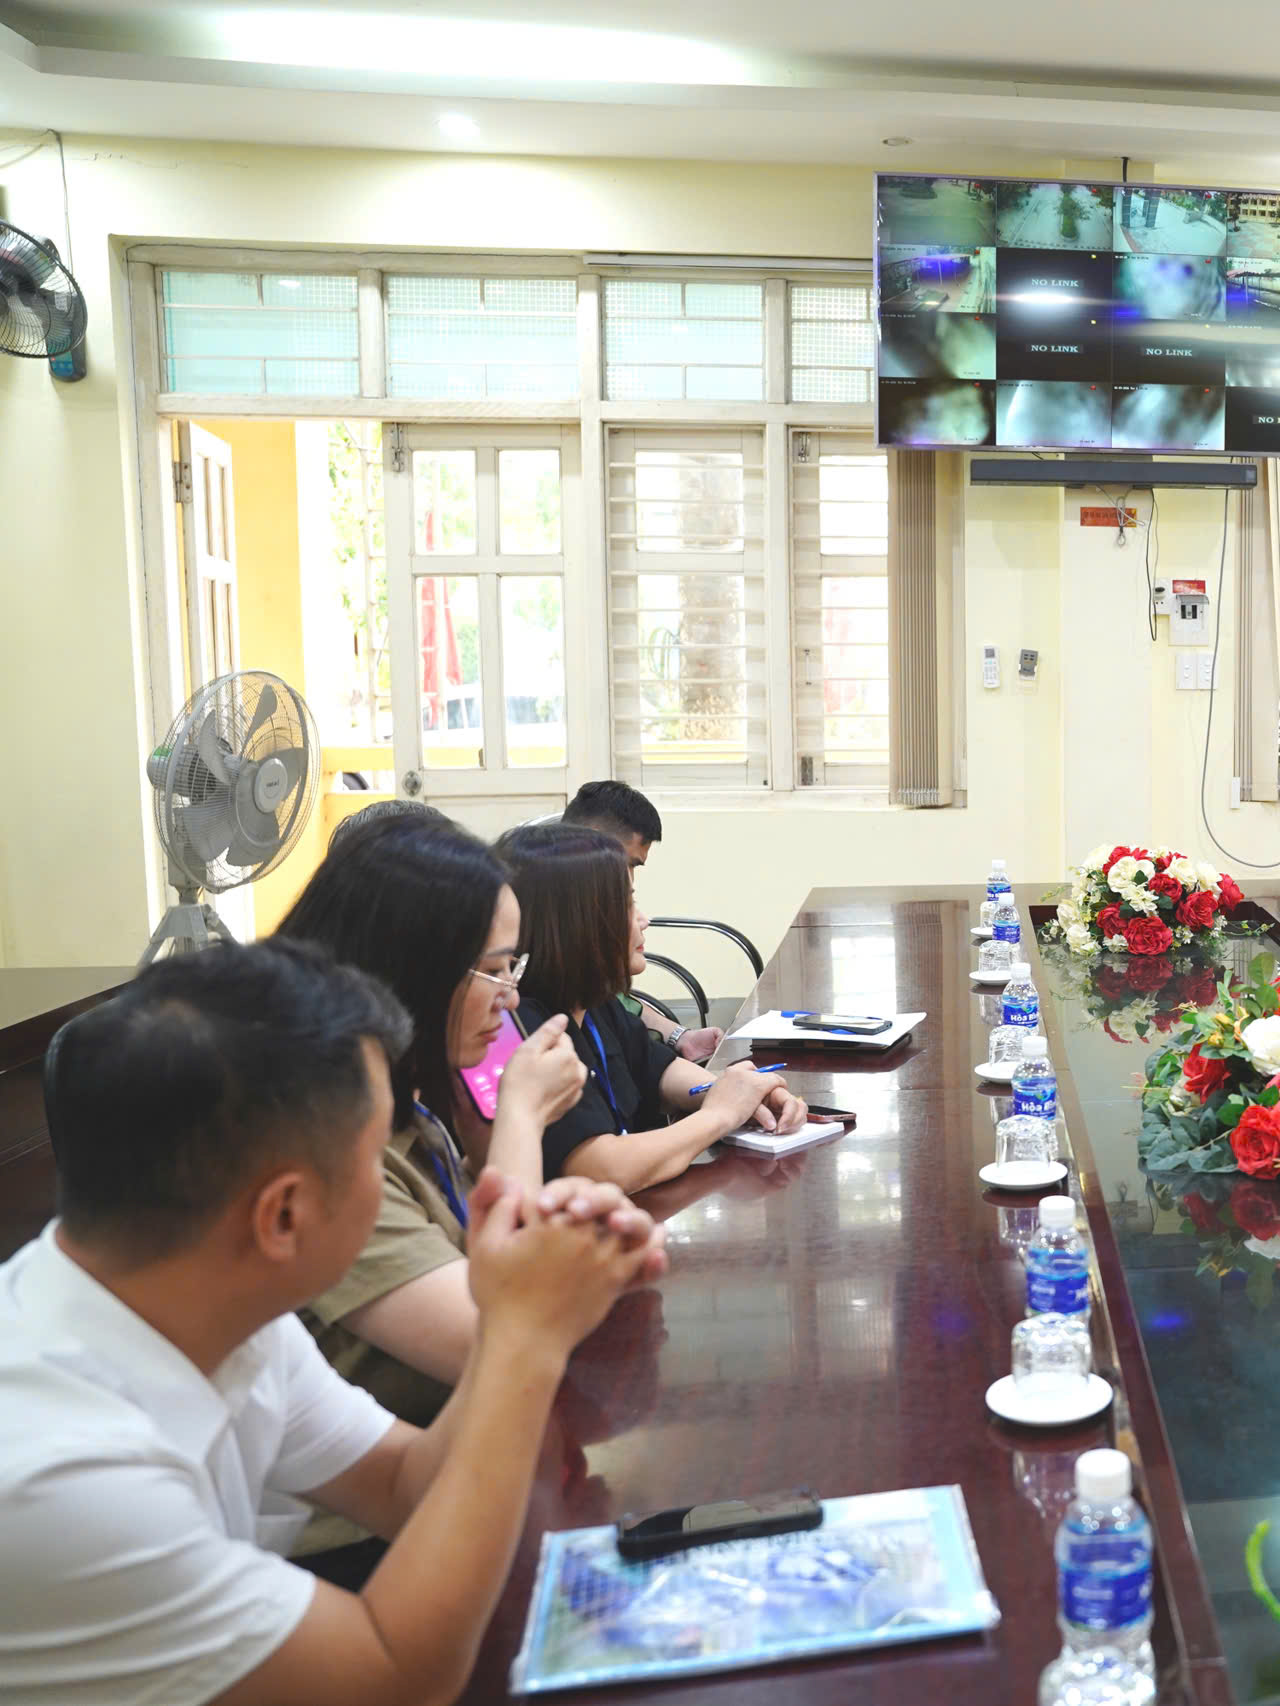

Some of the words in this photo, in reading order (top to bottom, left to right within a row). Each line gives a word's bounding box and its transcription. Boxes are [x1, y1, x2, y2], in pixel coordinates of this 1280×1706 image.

[1031, 278, 1048, 286] NO
[1051, 279, 1080, 287] LINK
[1031, 344, 1048, 352] NO
[1050, 345, 1079, 353] LINK
[1146, 348, 1163, 356] NO
[1165, 349, 1193, 357] LINK
[1258, 416, 1275, 424] NO
